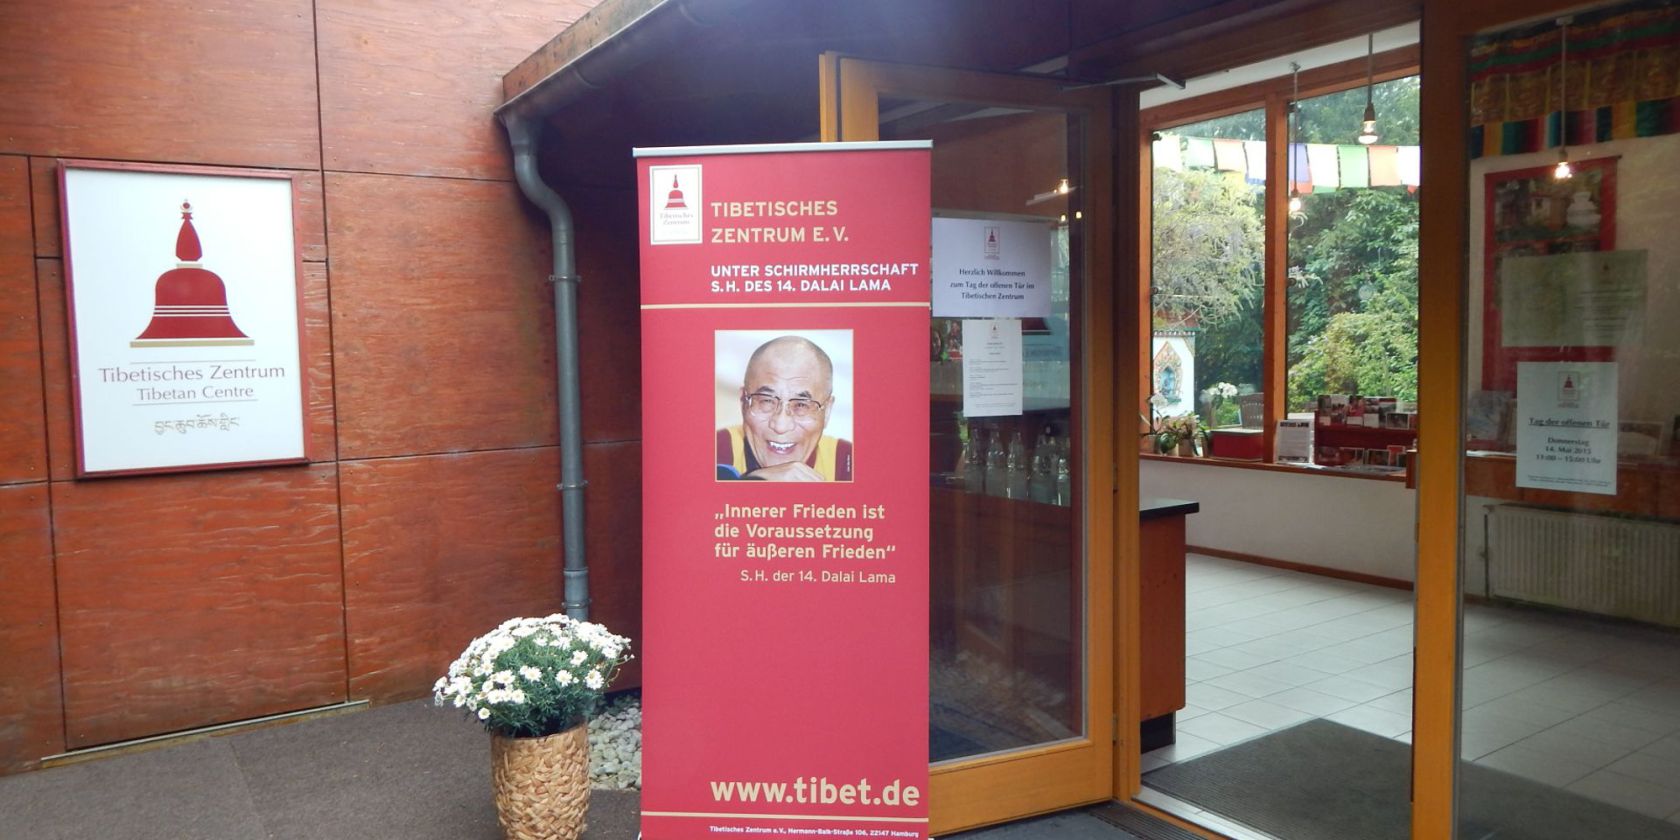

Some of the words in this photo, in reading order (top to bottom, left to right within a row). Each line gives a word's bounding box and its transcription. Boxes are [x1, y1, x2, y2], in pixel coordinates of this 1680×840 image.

[711, 201, 838, 217] TIBETISCHES
[711, 227, 806, 244] ZENTRUM
[711, 265, 760, 277] UNTER
[764, 263, 919, 276] SCHIRMHERRSCHAFT
[959, 268, 986, 276] Herzlich
[987, 268, 1026, 277] Willkommen
[744, 280, 773, 292] DES
[776, 280, 796, 292] 14.
[800, 279, 844, 291] DALAI
[849, 278, 892, 291] LAMA
[965, 281, 977, 290] Tag
[1014, 282, 1025, 290] Tür
[98, 366, 204, 382] Tibetisches
[209, 365, 286, 381] Zentrum
[136, 387, 197, 401] Tibetan
[202, 385, 255, 399] Centre
[714, 504, 787, 520] „Innerer
[793, 504, 857, 519] Frieden
[862, 504, 886, 519] ist
[714, 523, 740, 538] die
[746, 523, 874, 542] Voraussetzung
[714, 543, 740, 558] für
[746, 543, 815, 561] äußeren
[822, 544, 896, 560] Frieden“
[772, 570, 795, 582] der
[799, 570, 817, 582] 14.
[821, 570, 855, 583] Dalai
[859, 571, 896, 584] Lama
[710, 776, 920, 807] www.tibet.de
[709, 825, 744, 833] Tibetisches
[745, 826, 772, 834] Zentrum
[890, 830, 920, 838] Hamburg
